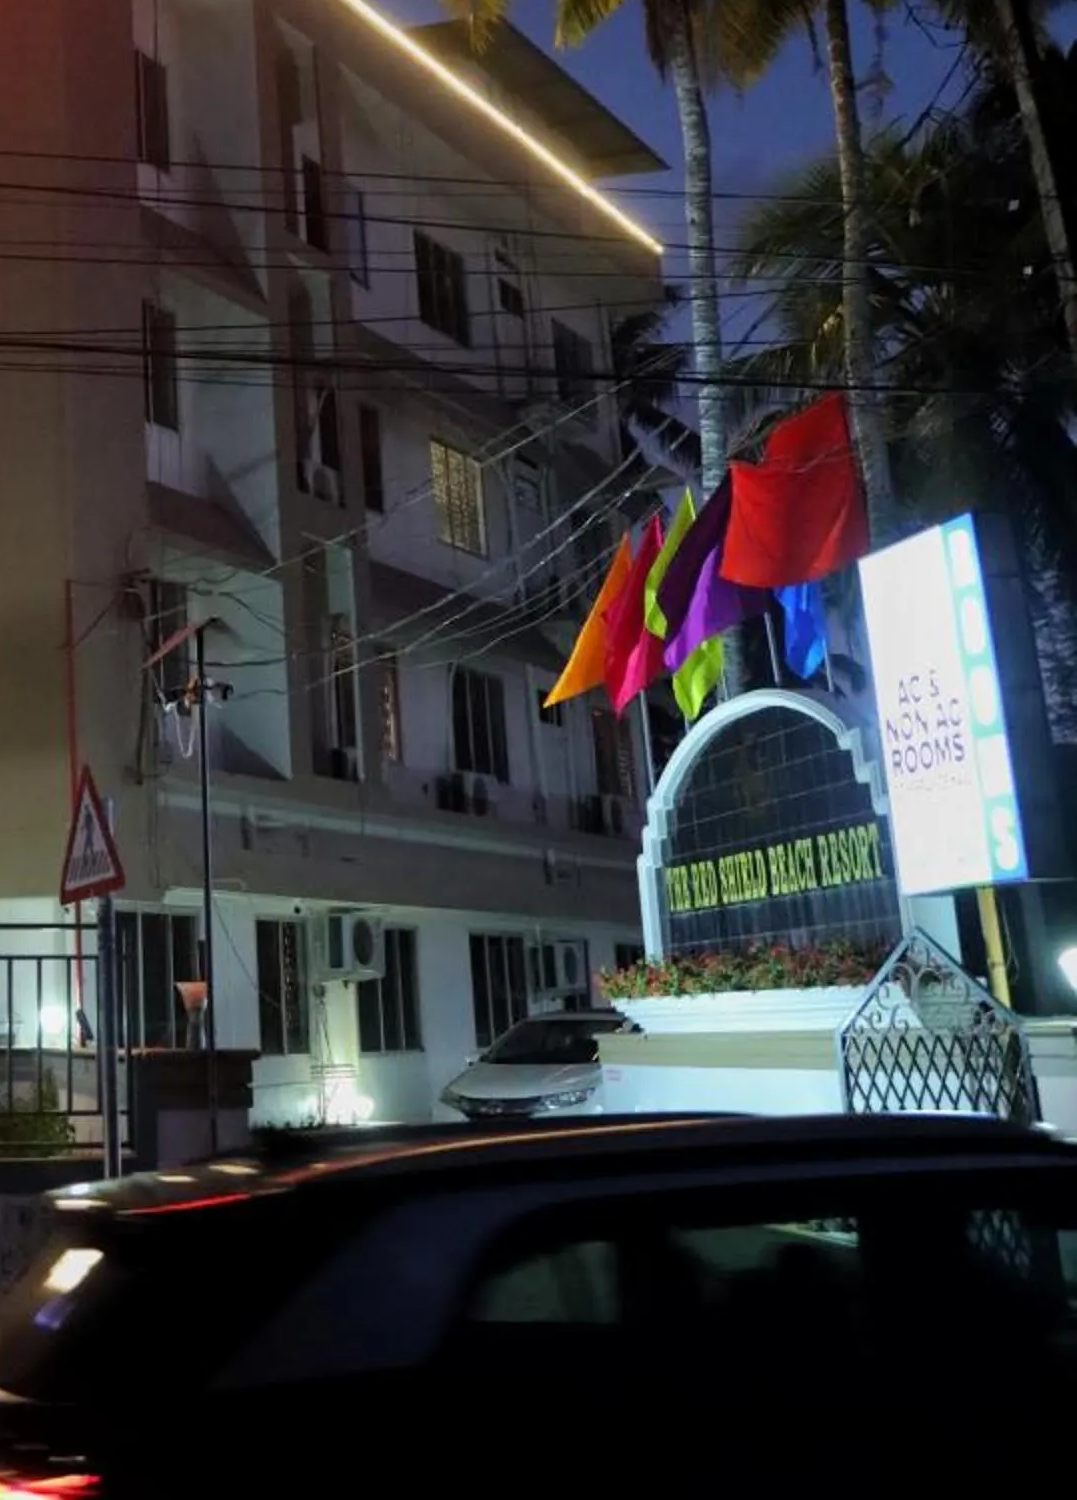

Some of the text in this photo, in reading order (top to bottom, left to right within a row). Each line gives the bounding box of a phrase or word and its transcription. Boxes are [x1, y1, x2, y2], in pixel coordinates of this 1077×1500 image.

[898, 674, 922, 705] AC
[885, 697, 963, 743] NON AC
[890, 732, 966, 777] ROOMS
[666, 823, 883, 911] THE RED SHIELD BEACH RESORT
